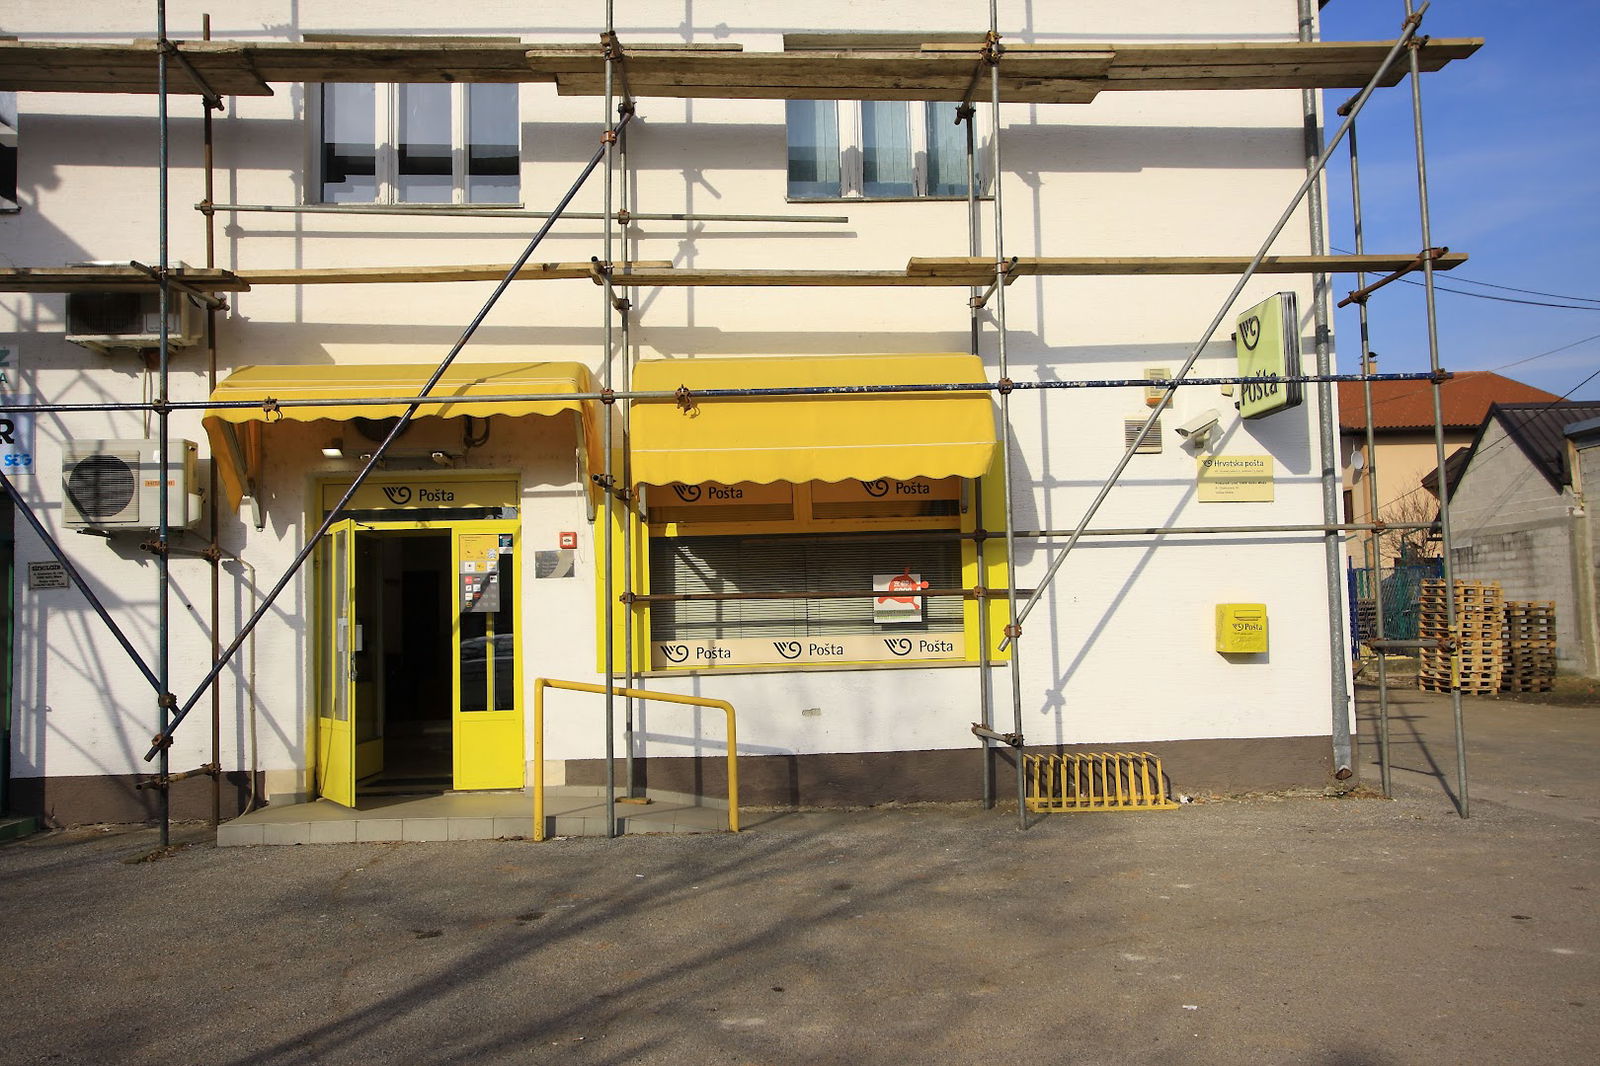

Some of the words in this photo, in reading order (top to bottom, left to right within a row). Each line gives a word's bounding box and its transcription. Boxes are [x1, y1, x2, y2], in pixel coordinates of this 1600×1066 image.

[1241, 369, 1278, 406] Pošta
[1214, 459, 1244, 467] Hrvatska
[1244, 459, 1264, 468] pošta
[708, 486, 743, 499] Pošta
[896, 481, 930, 494] Pošta
[419, 488, 454, 502] Pošta
[696, 645, 731, 660] Pošta
[809, 643, 844, 656] Pošta
[919, 640, 953, 653] Pošta
